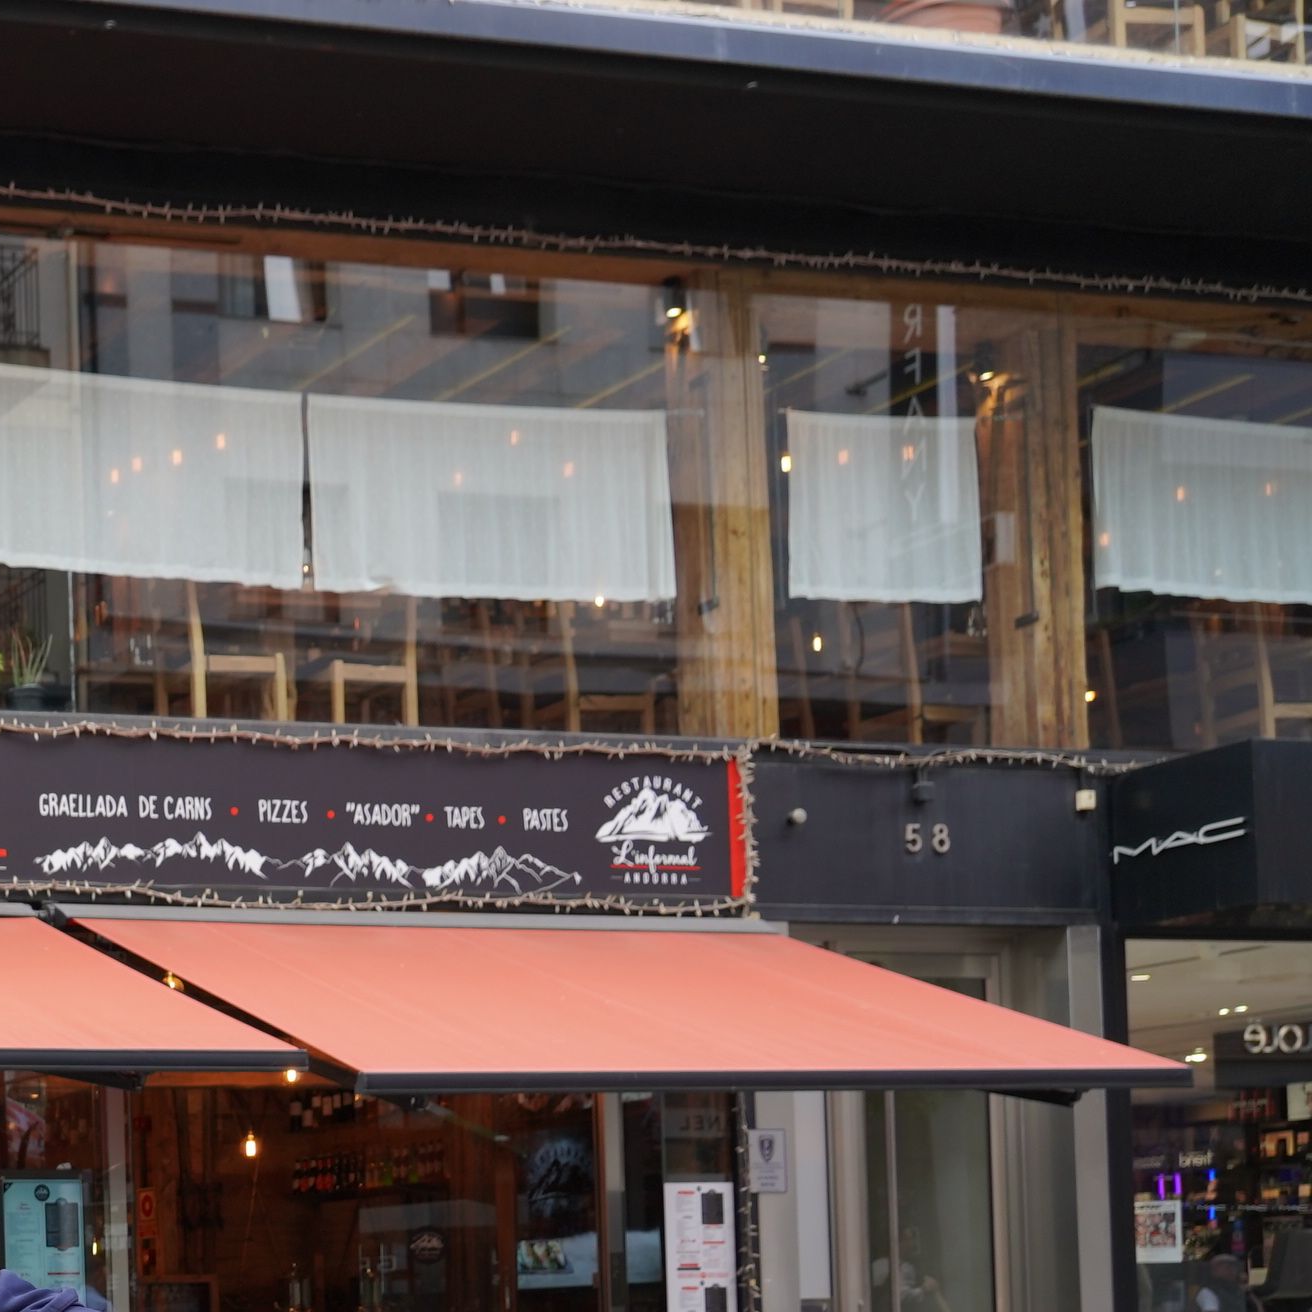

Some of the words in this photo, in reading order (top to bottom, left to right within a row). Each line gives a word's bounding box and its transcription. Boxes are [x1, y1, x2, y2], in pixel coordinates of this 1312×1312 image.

[603, 775, 703, 809] RESTAURANT
[39, 793, 127, 819] GRAELLADA
[138, 796, 159, 820] DE
[163, 796, 212, 822] CARNS
[258, 799, 308, 824] PIZZES
[444, 805, 485, 830] TAPES
[523, 807, 568, 832] PASTES
[904, 823, 951, 854] 58
[1112, 816, 1246, 864] MAC
[624, 872, 688, 886] ANDORRA
